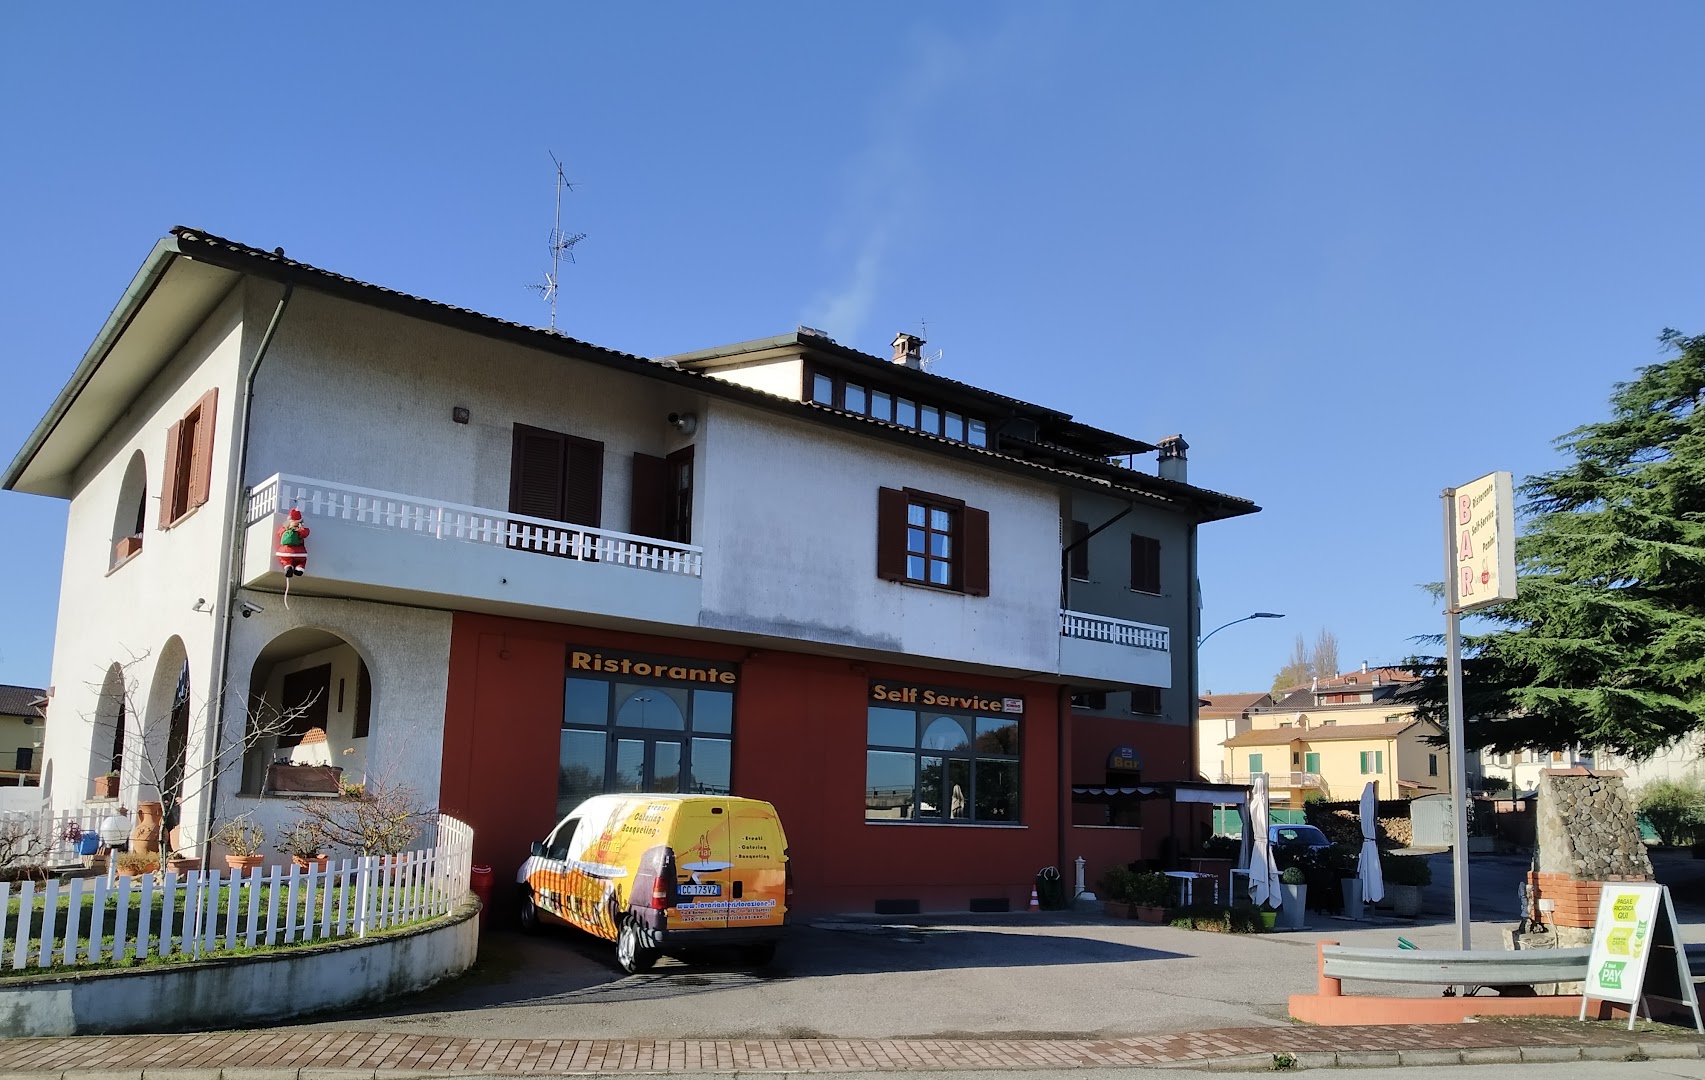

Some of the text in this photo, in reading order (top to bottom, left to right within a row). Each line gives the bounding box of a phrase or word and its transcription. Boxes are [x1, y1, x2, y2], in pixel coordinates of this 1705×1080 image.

[1472, 483, 1493, 509] Ristorante
[1458, 494, 1474, 597] BAR
[1482, 533, 1495, 552] Panini
[571, 651, 736, 684] Ristorante
[873, 684, 1002, 712] Self Service
[1114, 756, 1139, 768] Bar
[682, 885, 692, 894] CC
[1601, 969, 1622, 982] PAY
